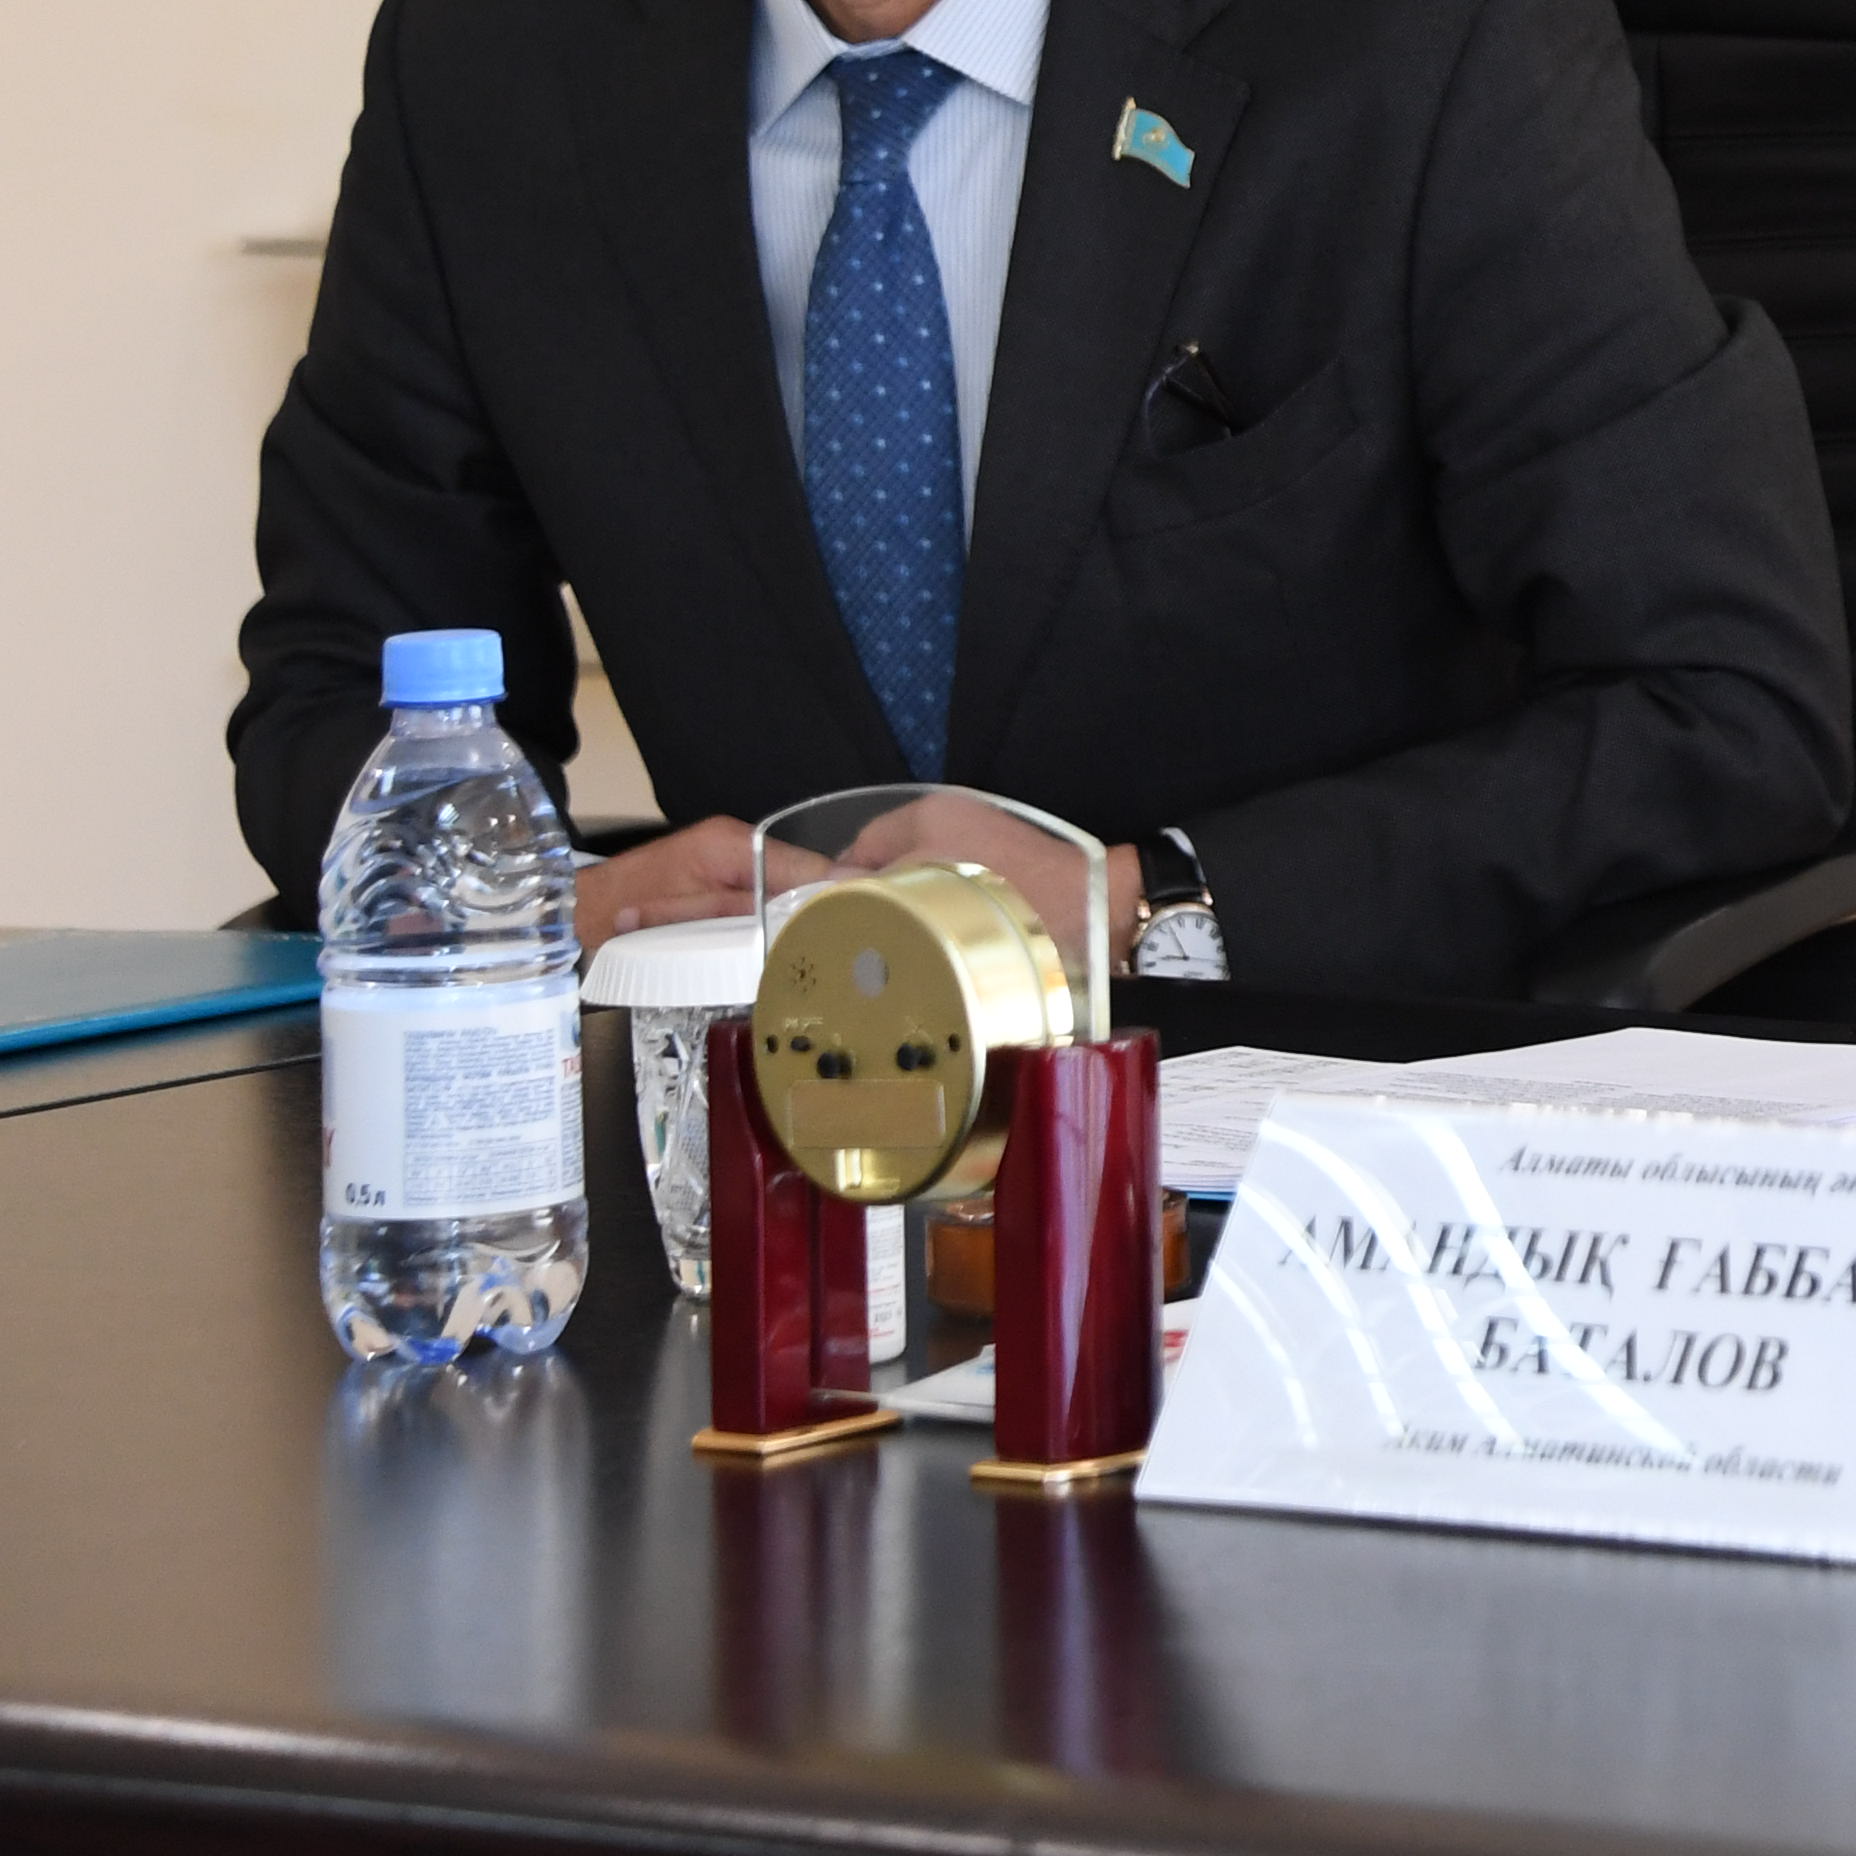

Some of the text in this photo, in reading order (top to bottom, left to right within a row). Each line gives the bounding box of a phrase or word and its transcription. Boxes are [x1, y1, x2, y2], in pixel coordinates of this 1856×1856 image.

[1500, 1145, 1634, 1181] Алматы
[1640, 1151, 1824, 1199] облысының
[1277, 1214, 1632, 1302] АМНДЫҚ
[1473, 1432, 1699, 1474] Аматинской
[1703, 1444, 1845, 1486] области
